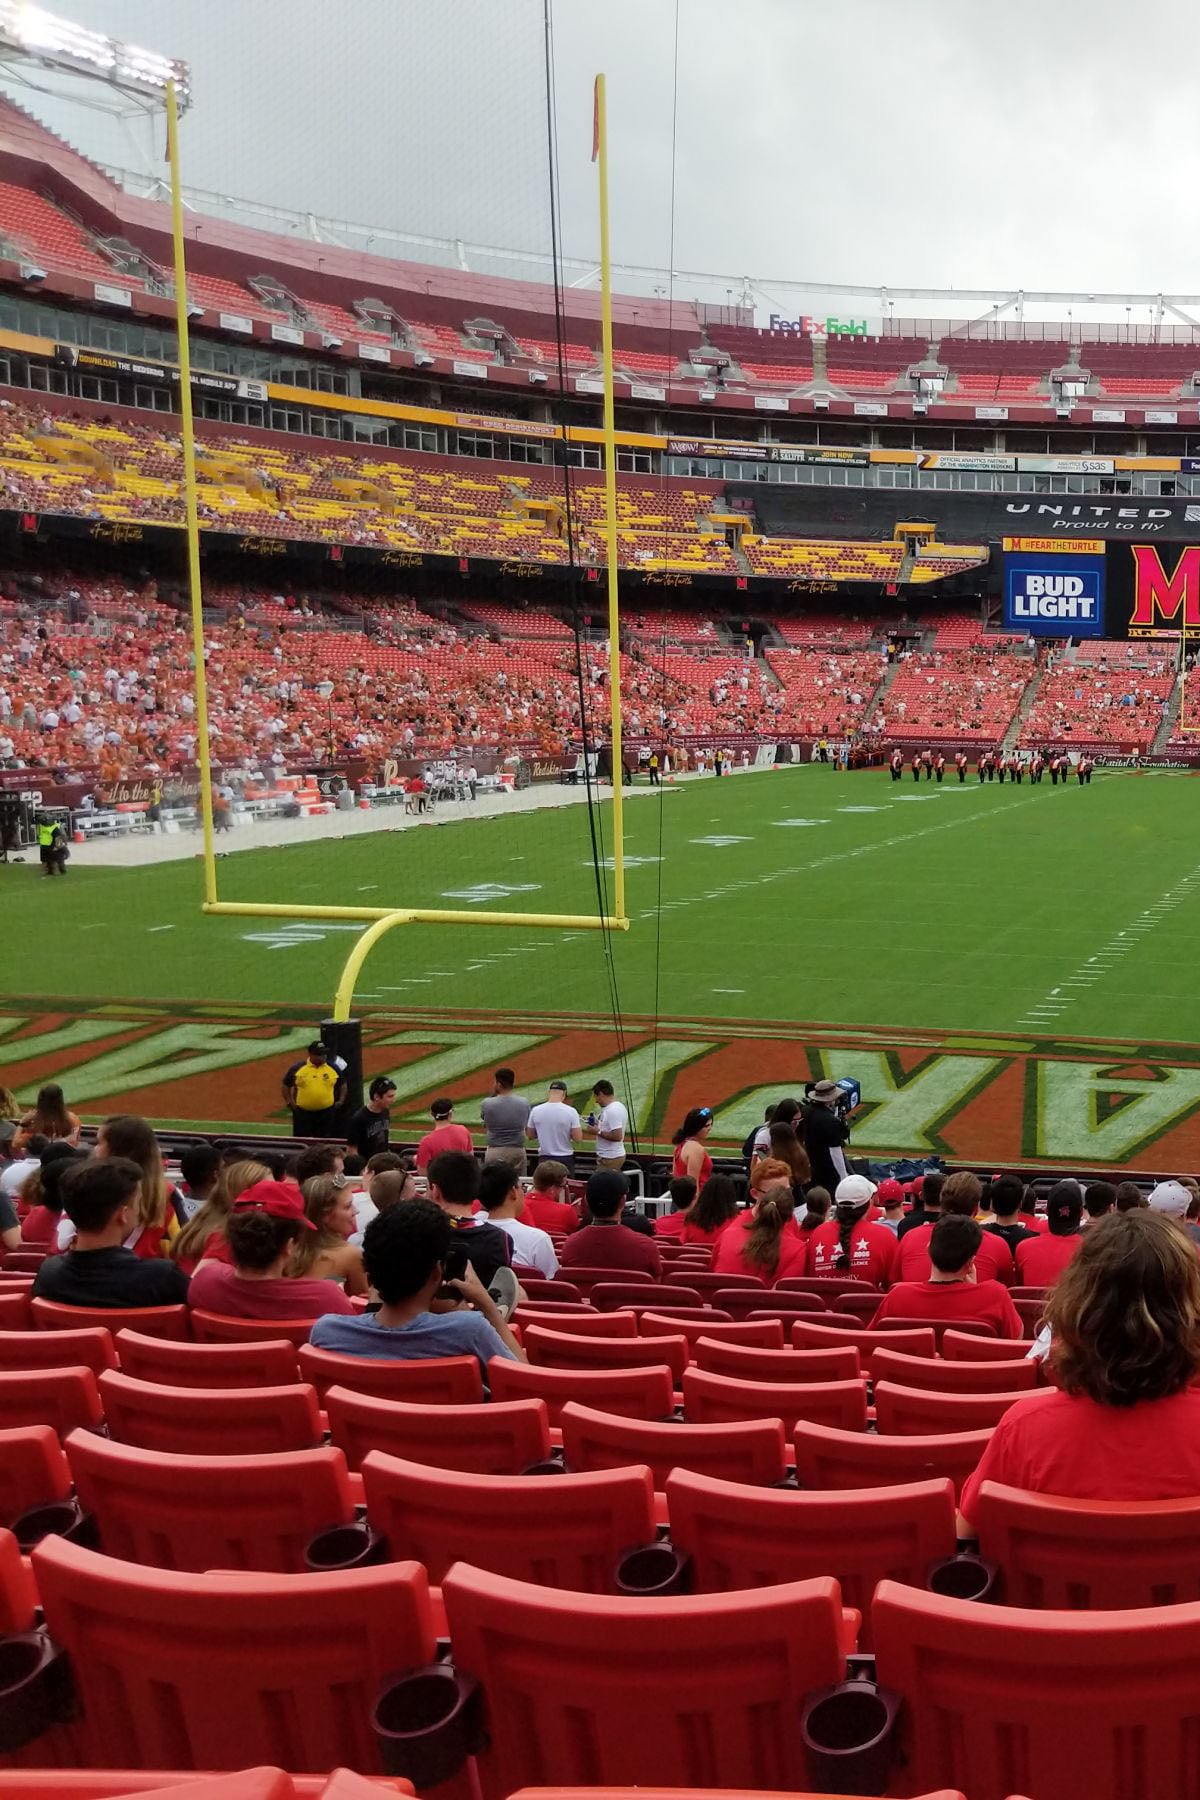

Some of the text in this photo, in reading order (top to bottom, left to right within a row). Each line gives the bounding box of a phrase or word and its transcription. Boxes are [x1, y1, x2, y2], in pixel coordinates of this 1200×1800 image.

[769, 314, 867, 335] FedExField
[118, 361, 131, 371] THE
[1089, 461, 1106, 471] sas
[1006, 503, 1172, 518] UNITED
[1052, 520, 1165, 531] Proud to fly
[1025, 540, 1097, 551] #FEARTHETURTLE
[1026, 575, 1084, 596] BUD
[1015, 596, 1094, 617] LIGHT
[533, 761, 563, 777] Redskins
[1139, 756, 1190, 768] Foundation
[119, 785, 129, 801] to
[131, 782, 149, 801] the
